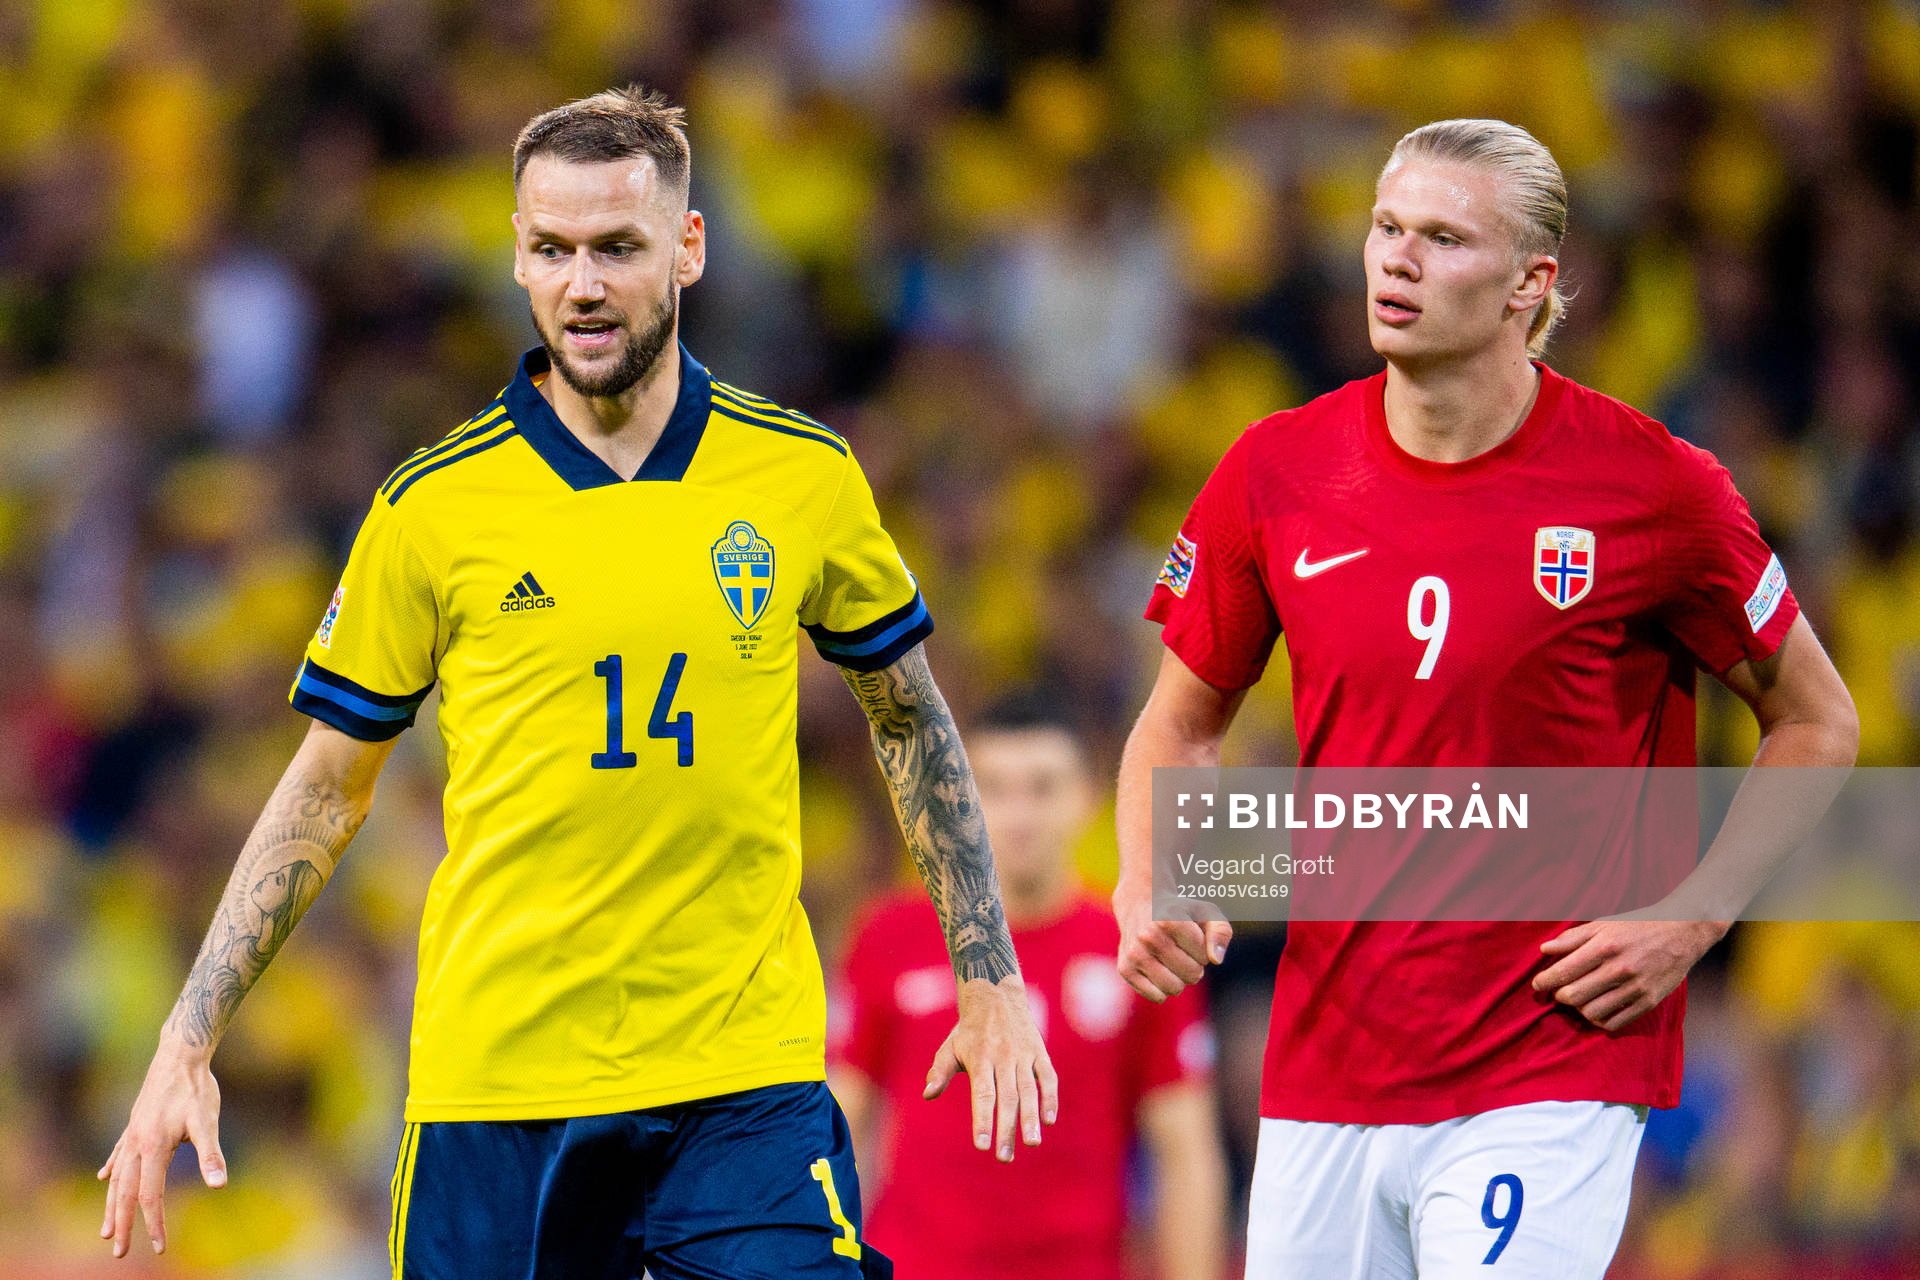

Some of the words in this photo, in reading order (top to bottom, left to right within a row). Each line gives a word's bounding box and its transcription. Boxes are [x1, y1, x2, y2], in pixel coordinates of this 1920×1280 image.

[500, 595, 556, 612] adidas
[723, 553, 765, 562] SVERIGE
[1407, 575, 1451, 680] 9
[591, 652, 694, 769] 14
[810, 1158, 861, 1261] 1
[1481, 1173, 1524, 1265] 9
